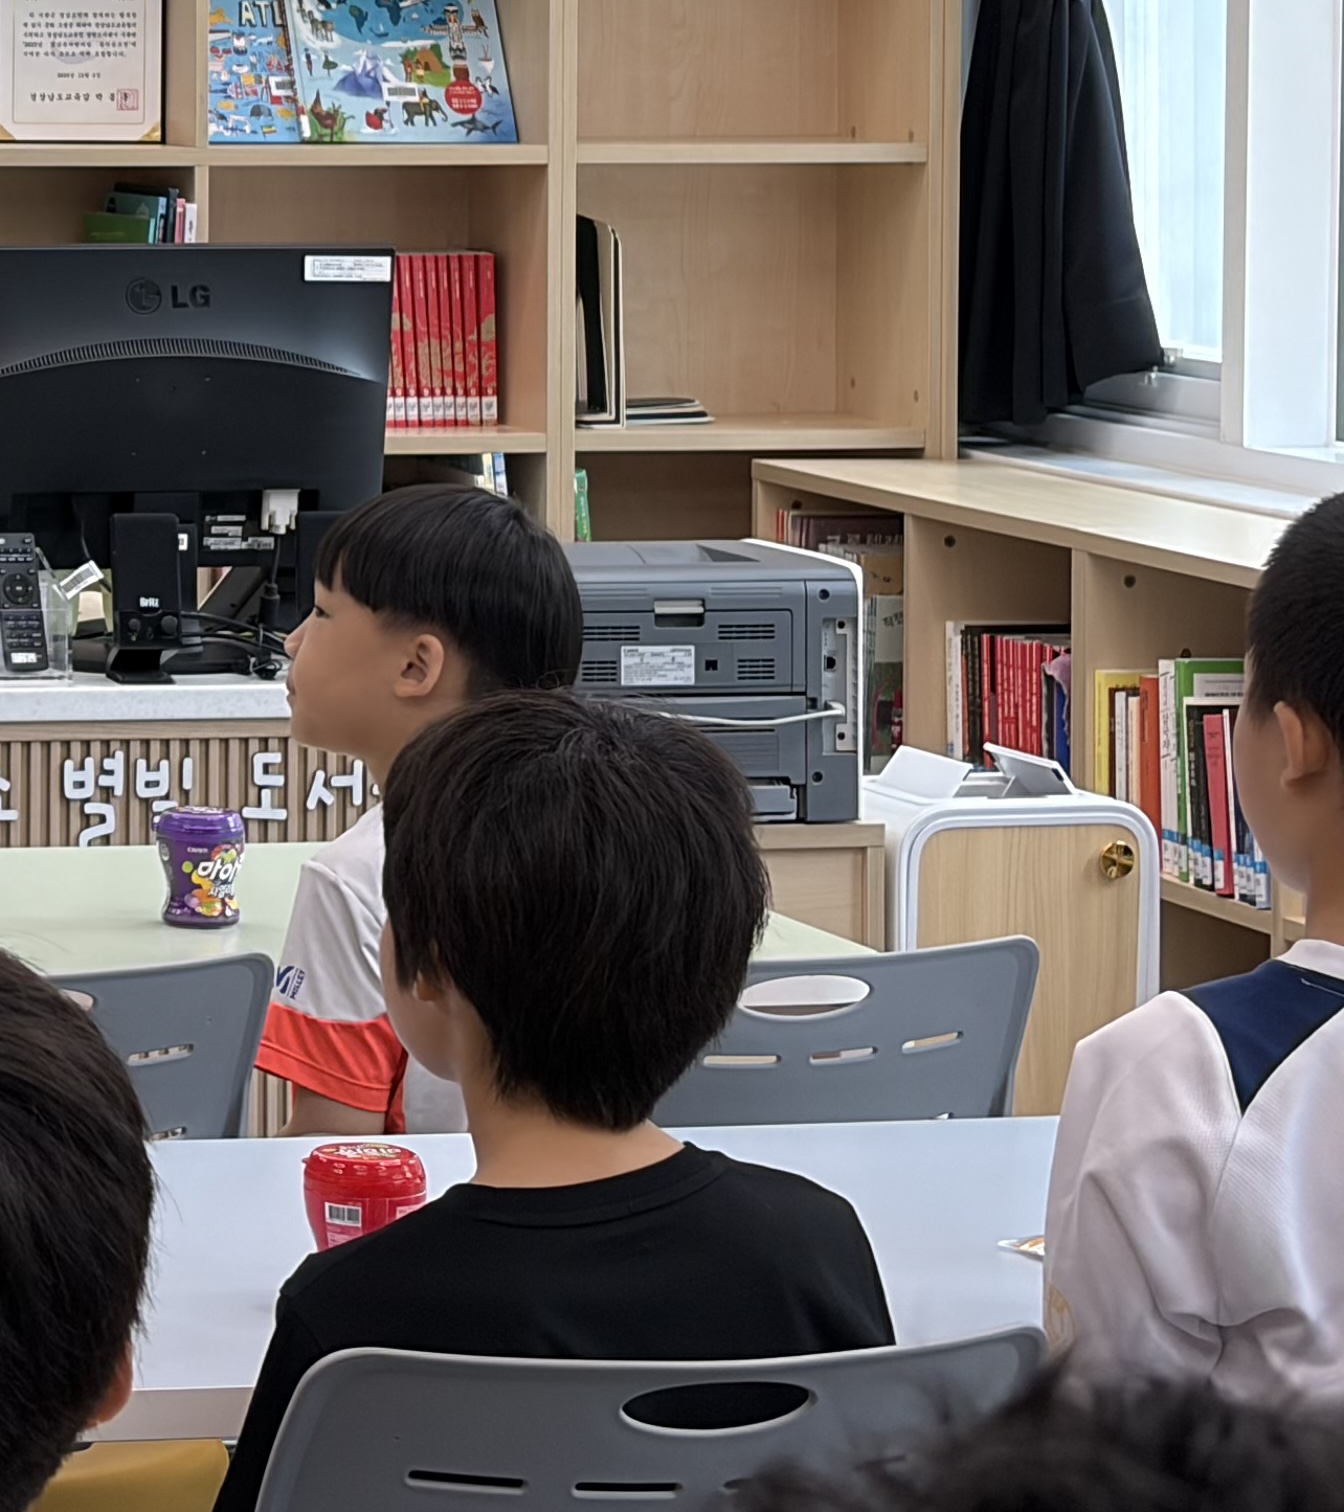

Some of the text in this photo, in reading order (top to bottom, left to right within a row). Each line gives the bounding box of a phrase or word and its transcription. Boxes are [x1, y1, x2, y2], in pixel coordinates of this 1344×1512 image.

[241, 0, 285, 28] ATL
[171, 283, 211, 309] LG
[242, 751, 380, 821] 도서
[197, 854, 244, 883] 마이
